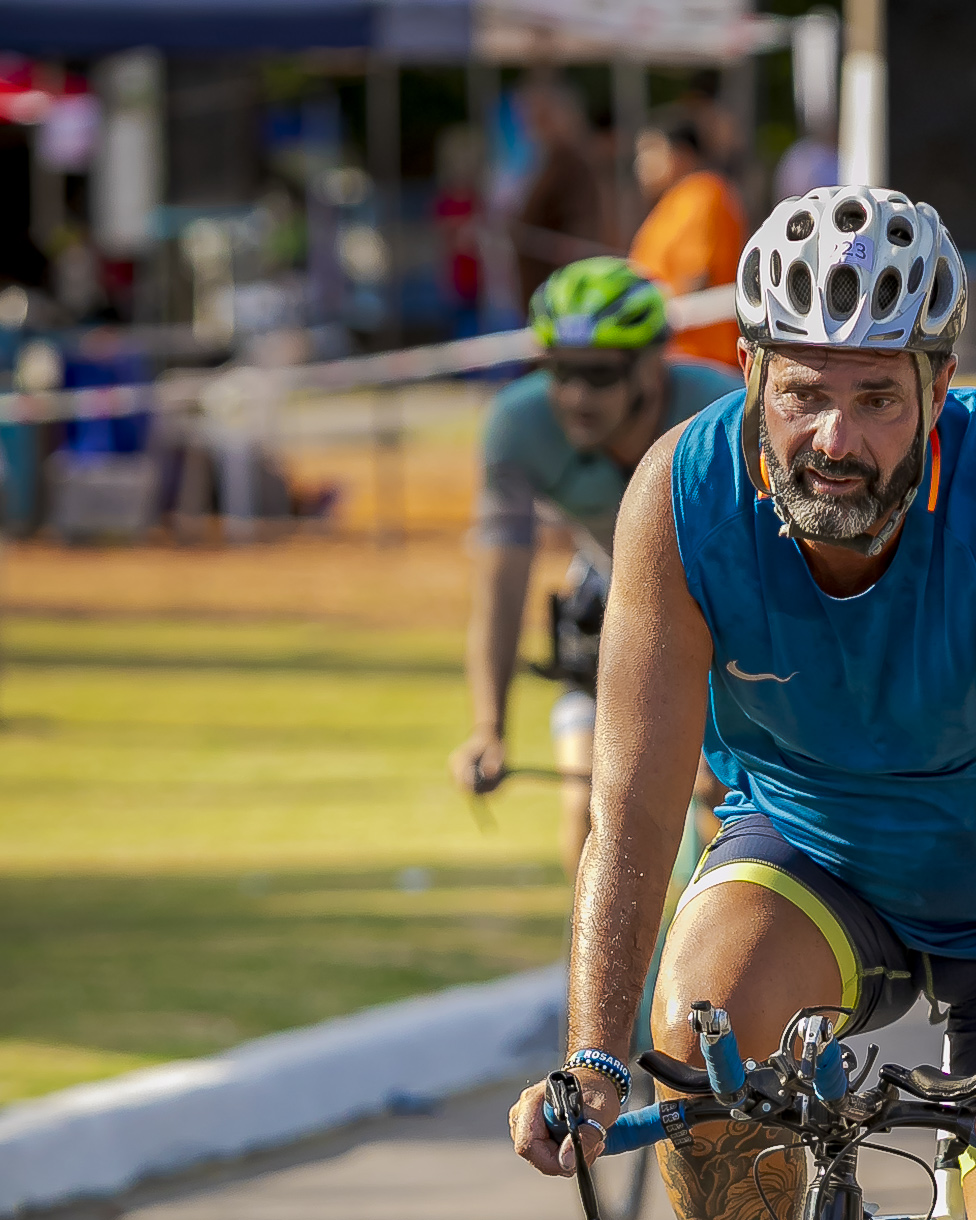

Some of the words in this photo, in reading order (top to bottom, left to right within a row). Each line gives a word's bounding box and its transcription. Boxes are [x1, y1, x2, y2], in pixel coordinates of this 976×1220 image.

[842, 241, 866, 259] 23
[583, 1050, 628, 1076] ROSARIO
[662, 1112, 680, 1124] PRO
